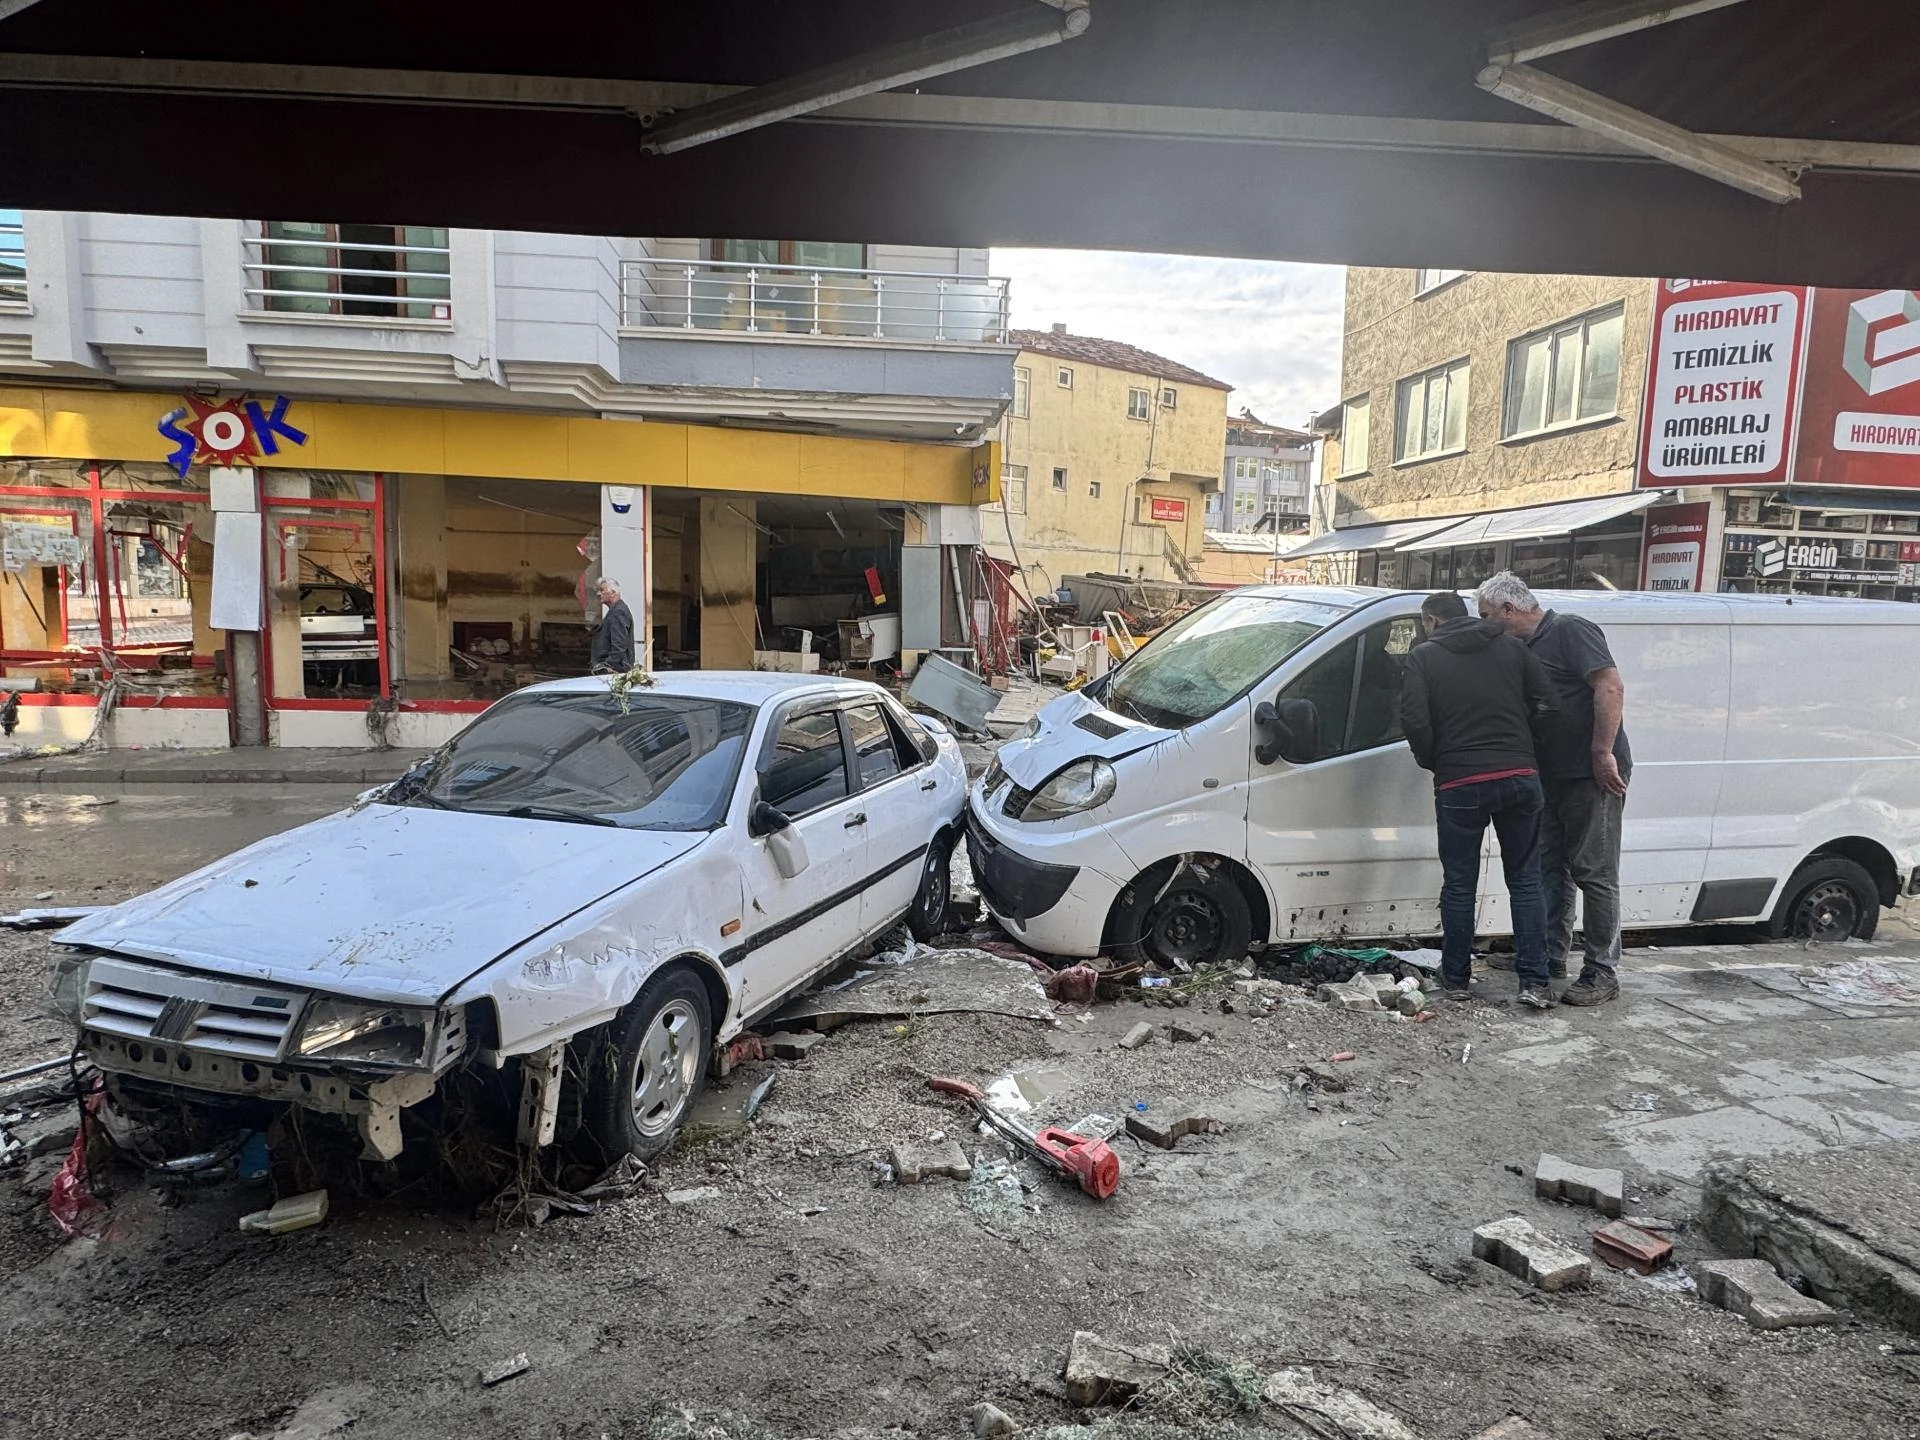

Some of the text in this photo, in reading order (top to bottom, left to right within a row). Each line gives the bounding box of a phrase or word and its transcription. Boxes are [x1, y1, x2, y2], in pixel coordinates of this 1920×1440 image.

[1673, 303, 1783, 333] HIRDAVAT
[1672, 340, 1774, 370] TEMİZLİK
[1673, 376, 1764, 405] PLASTİK
[157, 395, 309, 478] ŞOK
[1663, 413, 1771, 438] AMBALAJ
[1662, 440, 1766, 468] ÜRÜNLERİ
[1652, 551, 1694, 564] HIRDAVAT
[1787, 542, 1838, 568] ERGİN
[1651, 576, 1690, 591] TEMİZLİK
